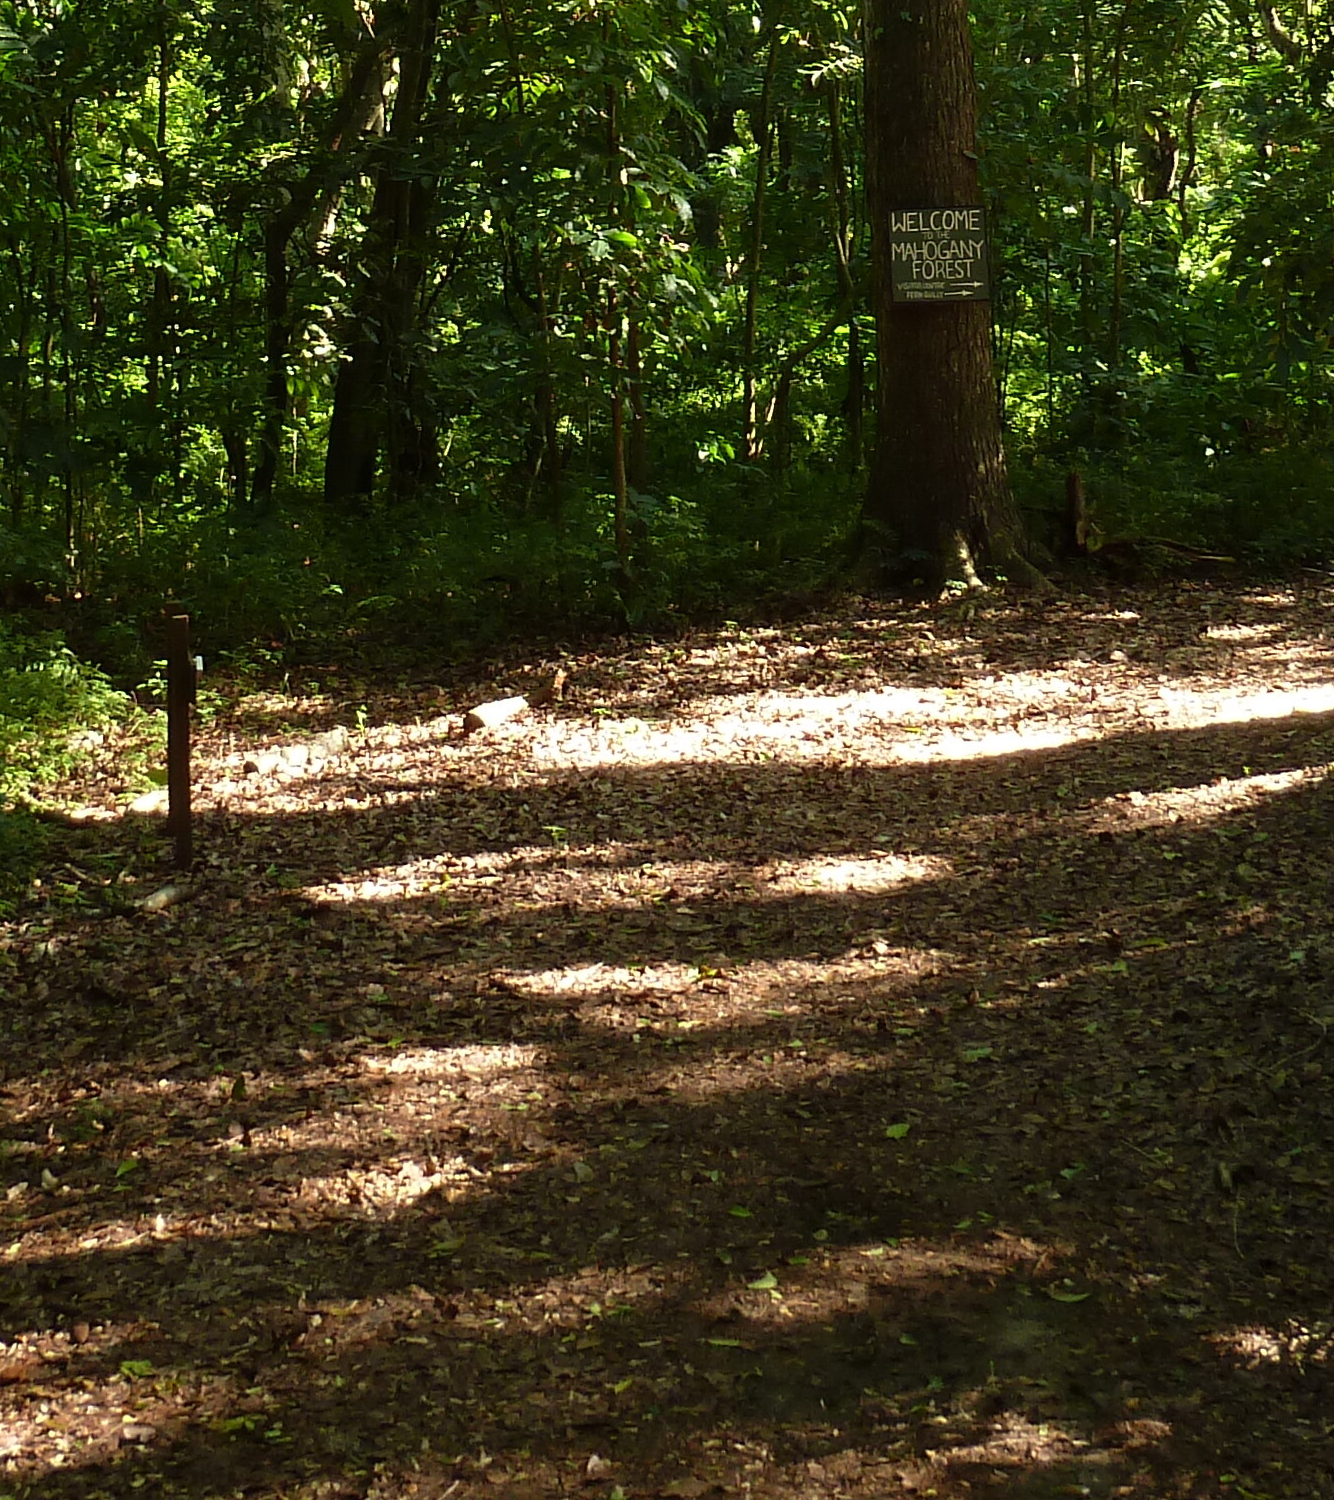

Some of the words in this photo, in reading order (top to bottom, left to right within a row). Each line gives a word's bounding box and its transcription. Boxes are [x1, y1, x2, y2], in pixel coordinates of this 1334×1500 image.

[891, 210, 980, 232] WELCOME
[922, 231, 933, 239] TO
[937, 231, 951, 239] THE
[891, 240, 984, 261] MAHOGANY
[912, 259, 974, 279] FOREST
